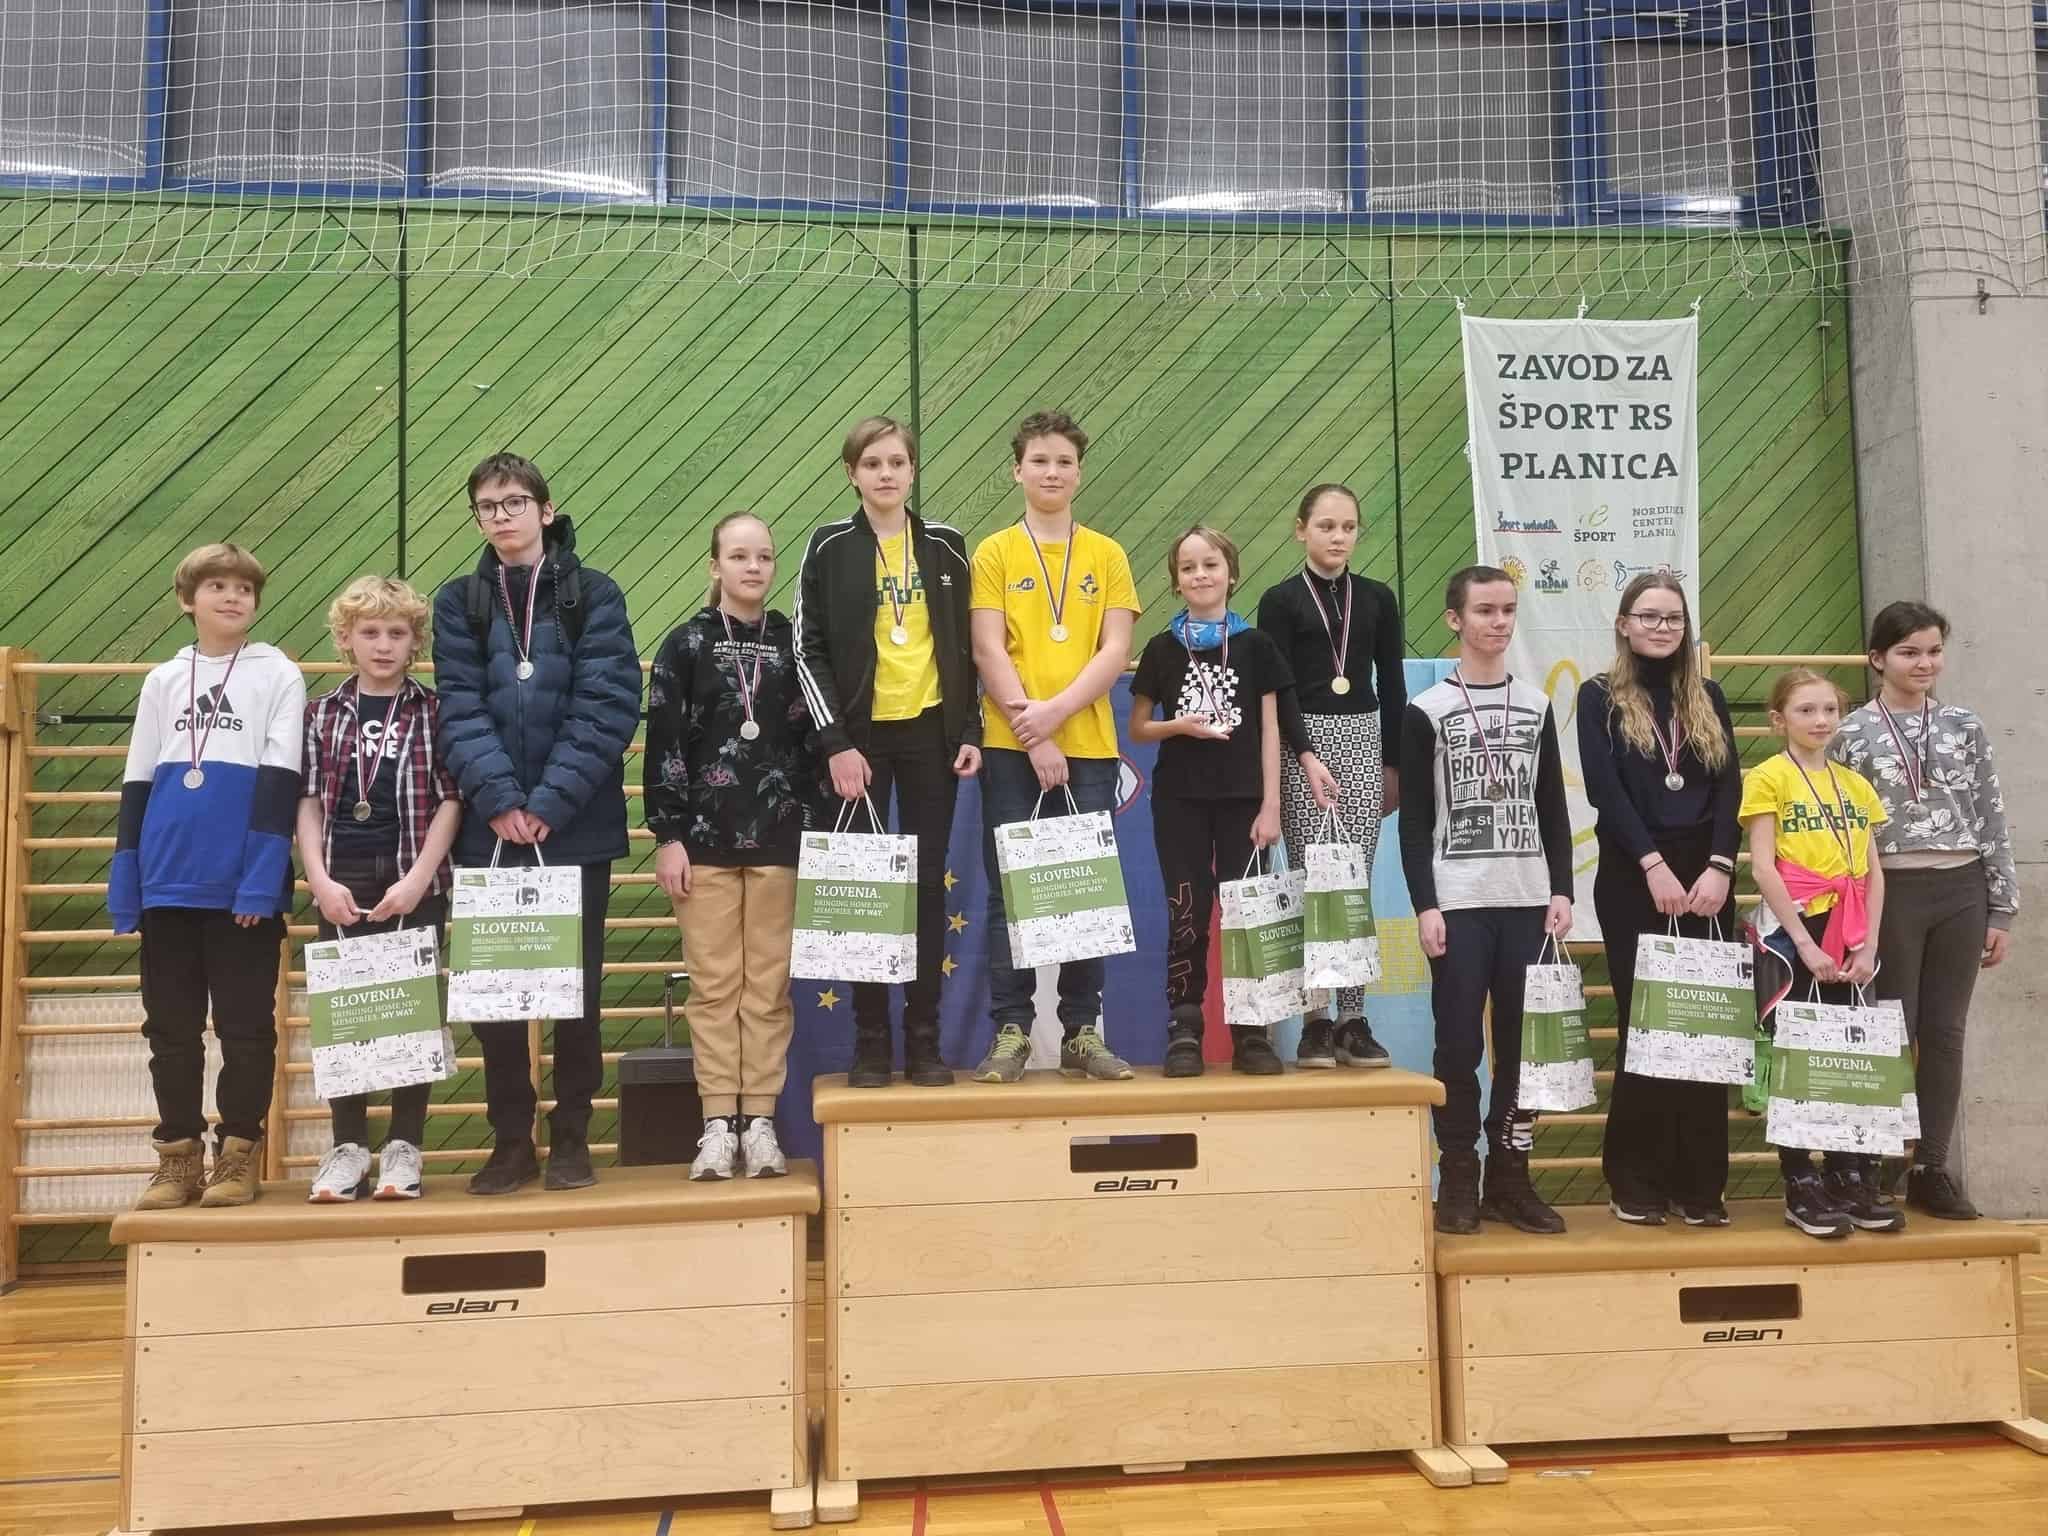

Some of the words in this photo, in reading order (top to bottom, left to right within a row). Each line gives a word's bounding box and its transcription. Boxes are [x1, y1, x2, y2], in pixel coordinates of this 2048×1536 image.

[1497, 353, 1619, 381] ZAVOD
[1626, 354, 1673, 381] ZA
[1498, 392, 1619, 431] ŠPORT
[1629, 403, 1673, 431] RS
[1499, 452, 1679, 480] PLANICA
[1573, 528, 1617, 543] ŠPORT
[174, 711, 244, 732] adidas
[1451, 753, 1516, 783] BROOK
[1481, 777, 1516, 800] LN
[1477, 815, 1493, 826] St
[1505, 804, 1537, 826] NEW
[1498, 827, 1538, 849] YORK
[1029, 865, 1098, 884] SLOVENIA.
[814, 885, 882, 899] SLOVENIA.
[471, 921, 550, 935] SLOVENIA.
[330, 986, 411, 1009] SLOVENIA.
[1666, 987, 1733, 1004] SLOVENIA.
[381, 1010, 395, 1020] MY
[1807, 1055, 1878, 1072] SLOVENIA.
[1094, 1176, 1178, 1192] elan
[426, 1298, 519, 1315] elan
[1703, 1327, 1783, 1343] elan
